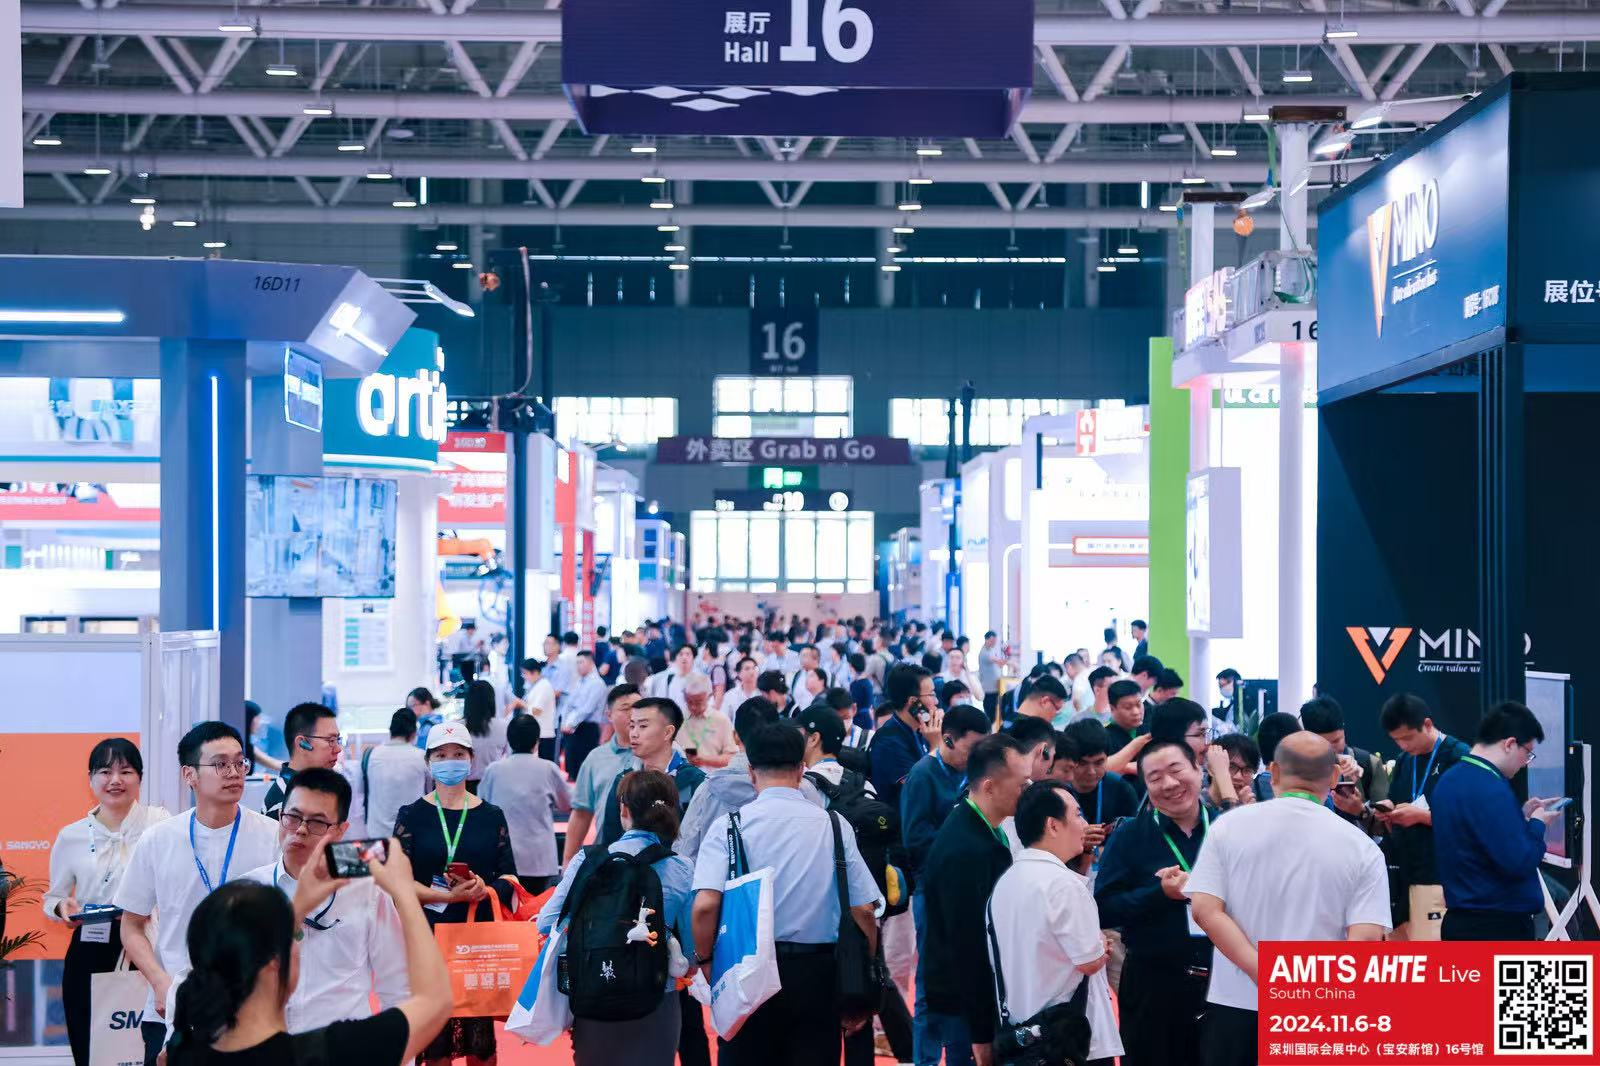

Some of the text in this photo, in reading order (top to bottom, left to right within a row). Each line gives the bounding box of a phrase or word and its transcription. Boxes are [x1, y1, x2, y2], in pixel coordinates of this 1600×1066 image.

[724, 11, 771, 34] 展厅
[780, 0, 874, 64] 16
[724, 41, 769, 63] Hall
[1391, 178, 1440, 267] MINO
[255, 276, 301, 292] 16D11
[1544, 279, 1600, 304] 展位
[762, 321, 806, 360] 16
[685, 437, 876, 461] 外卖区 Grab n Go
[1418, 663, 1444, 673] Create
[1445, 663, 1468, 673] value
